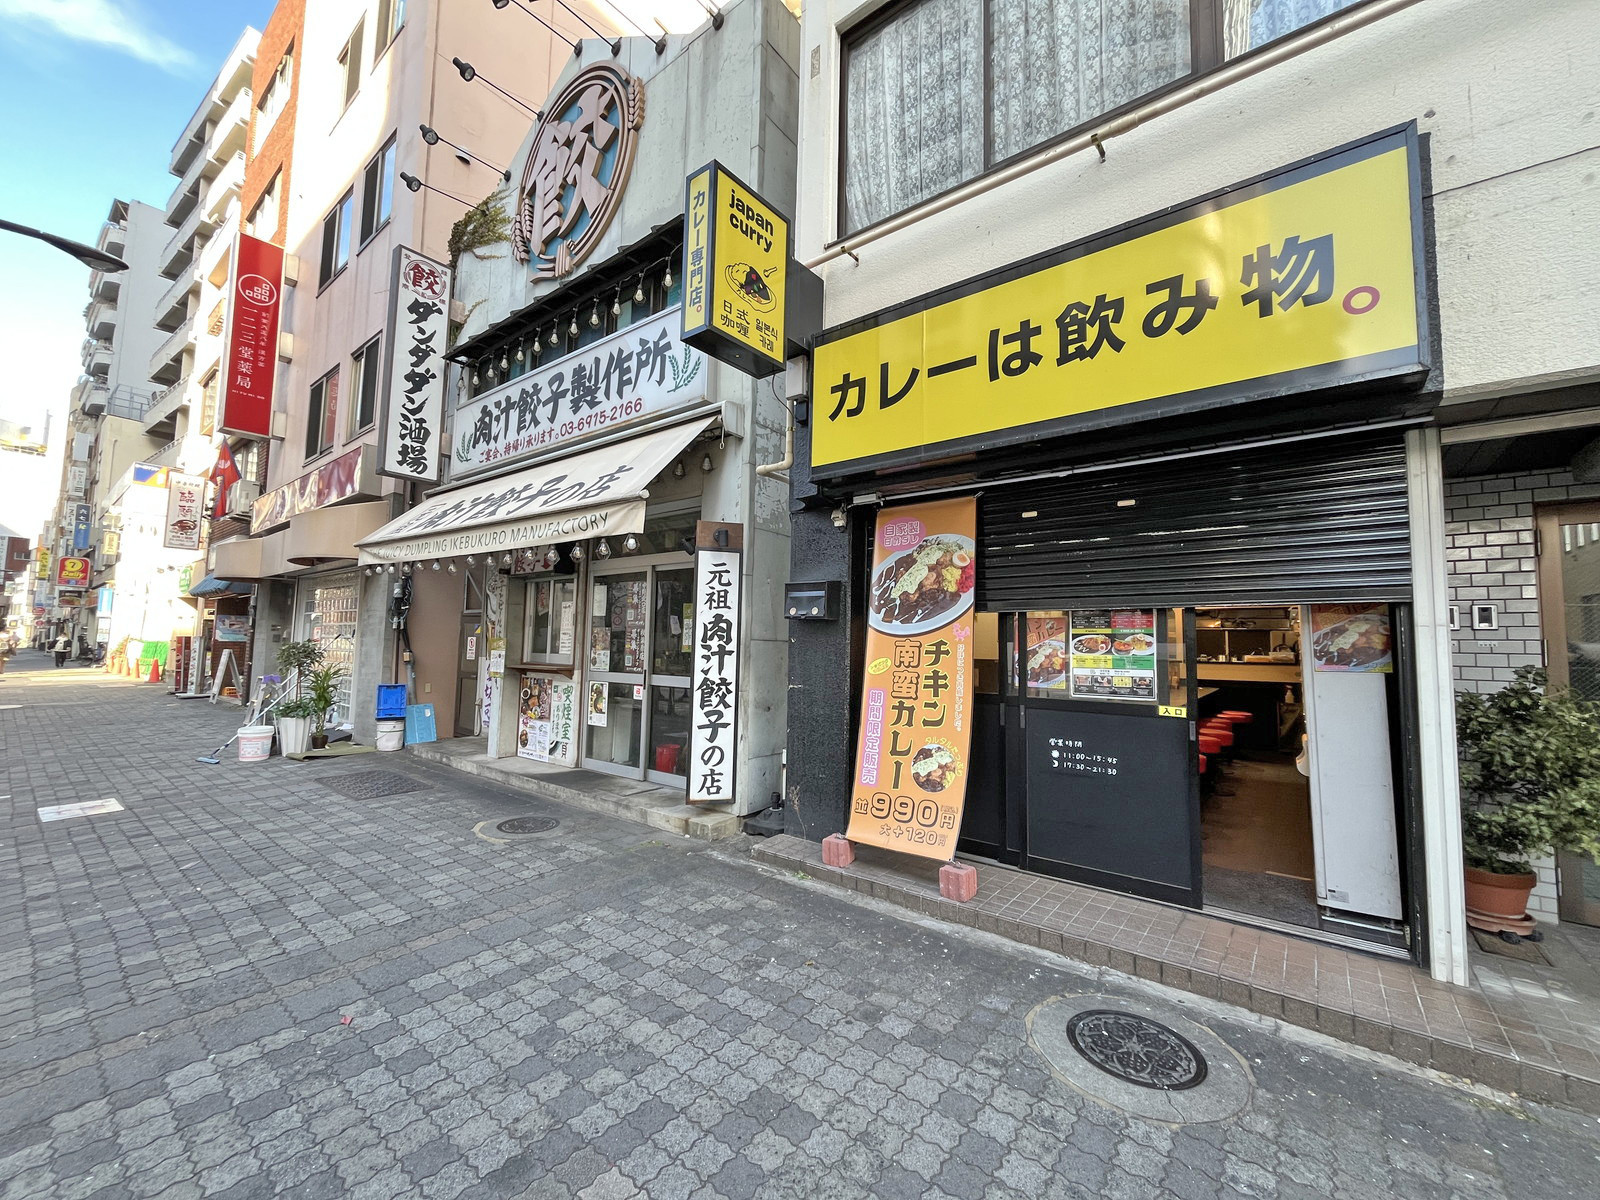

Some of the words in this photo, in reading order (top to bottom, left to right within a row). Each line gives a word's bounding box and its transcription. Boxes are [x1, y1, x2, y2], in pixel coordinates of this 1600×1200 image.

[729, 189, 774, 237] japan
[729, 212, 773, 253] curry
[688, 190, 705, 313] カレー専門店。
[409, 263, 440, 296] 餃
[723, 299, 750, 326] 日式
[755, 318, 778, 341] 일본식
[828, 233, 1381, 422] カレーは飲み物。
[759, 335, 774, 353] 카레
[396, 297, 443, 475] ダンダダン酒場
[472, 327, 672, 449] 肉汁餃子製作所
[404, 538, 447, 557] DUMPLING
[449, 530, 507, 552] IKEBUKURO
[510, 512, 609, 545] MANUFACTORY
[884, 521, 920, 536] 自家製
[61, 570, 85, 579] Daily
[695, 562, 735, 796] 元祖肉汁餃子の店
[921, 639, 951, 729] チキン
[888, 638, 923, 790] 南蛮カレー
[1163, 707, 1182, 716] 入口
[861, 689, 883, 785] 期間限定販売
